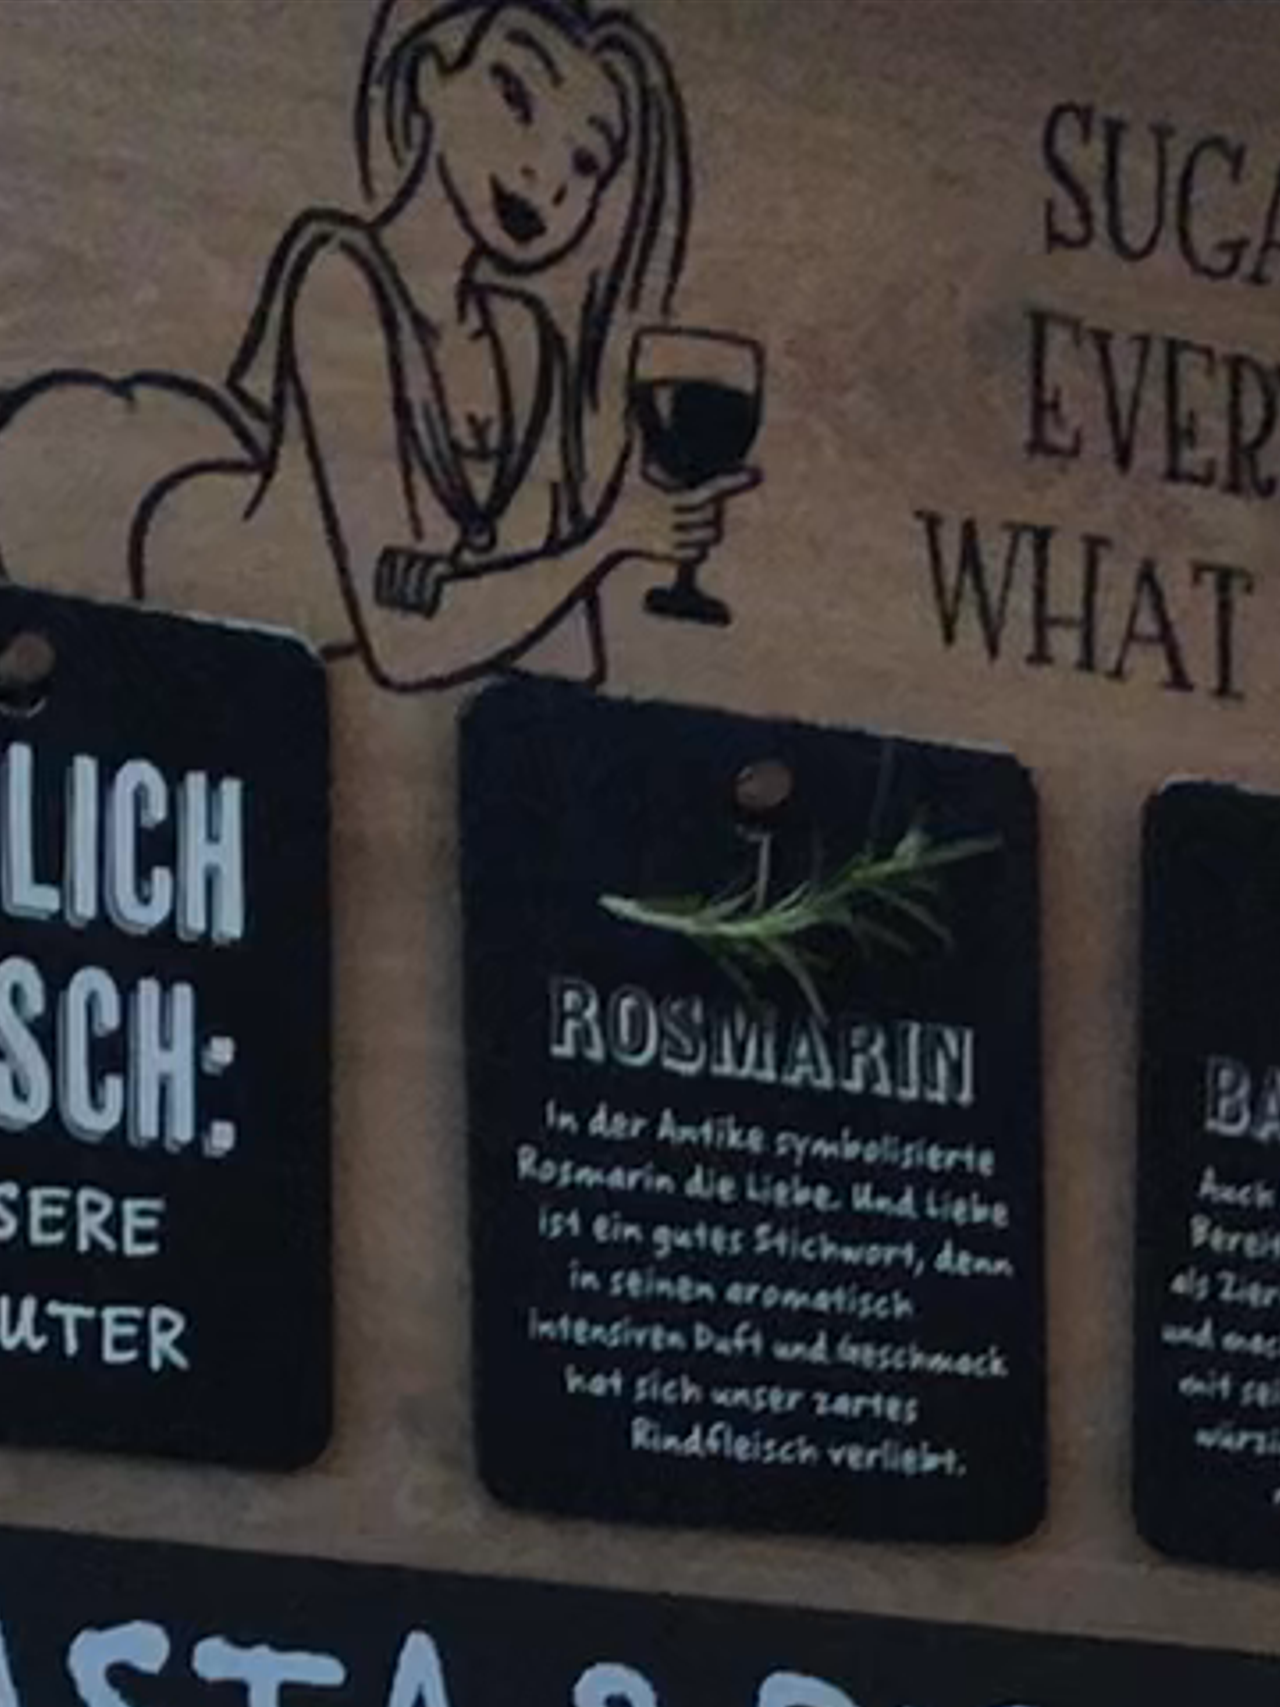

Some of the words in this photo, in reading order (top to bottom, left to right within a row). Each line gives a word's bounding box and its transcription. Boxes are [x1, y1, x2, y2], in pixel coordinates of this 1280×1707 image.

[914, 509, 1255, 702] WHAT
[548, 974, 977, 1108] ROSMARIN
[546, 1099, 578, 1136] In
[588, 1103, 648, 1140] der
[655, 1108, 763, 1155] Antike
[774, 1127, 996, 1178] symbolisierte
[517, 1144, 677, 1196] Rosmarin
[684, 1166, 737, 1203] die
[851, 1183, 918, 1220] Und
[924, 1191, 1010, 1229] Liebe
[1197, 1164, 1276, 1210] Auch
[538, 1206, 580, 1239] ist
[592, 1209, 644, 1246] ein
[651, 1219, 744, 1260] gutes
[753, 1223, 924, 1277] Stichwort,
[933, 1239, 1013, 1278] denn
[569, 1259, 601, 1292] in
[608, 1262, 718, 1304] seinen
[725, 1280, 915, 1322] aromatisch
[693, 1319, 765, 1358] Duft
[772, 1332, 830, 1366] und
[835, 1336, 1009, 1380] Geschmack
[1161, 1317, 1215, 1349] und
[565, 1363, 624, 1397] hat
[633, 1370, 703, 1405] sich
[711, 1382, 803, 1413] unser
[813, 1389, 918, 1425] zartes
[630, 1417, 820, 1466] Rindfleisch
